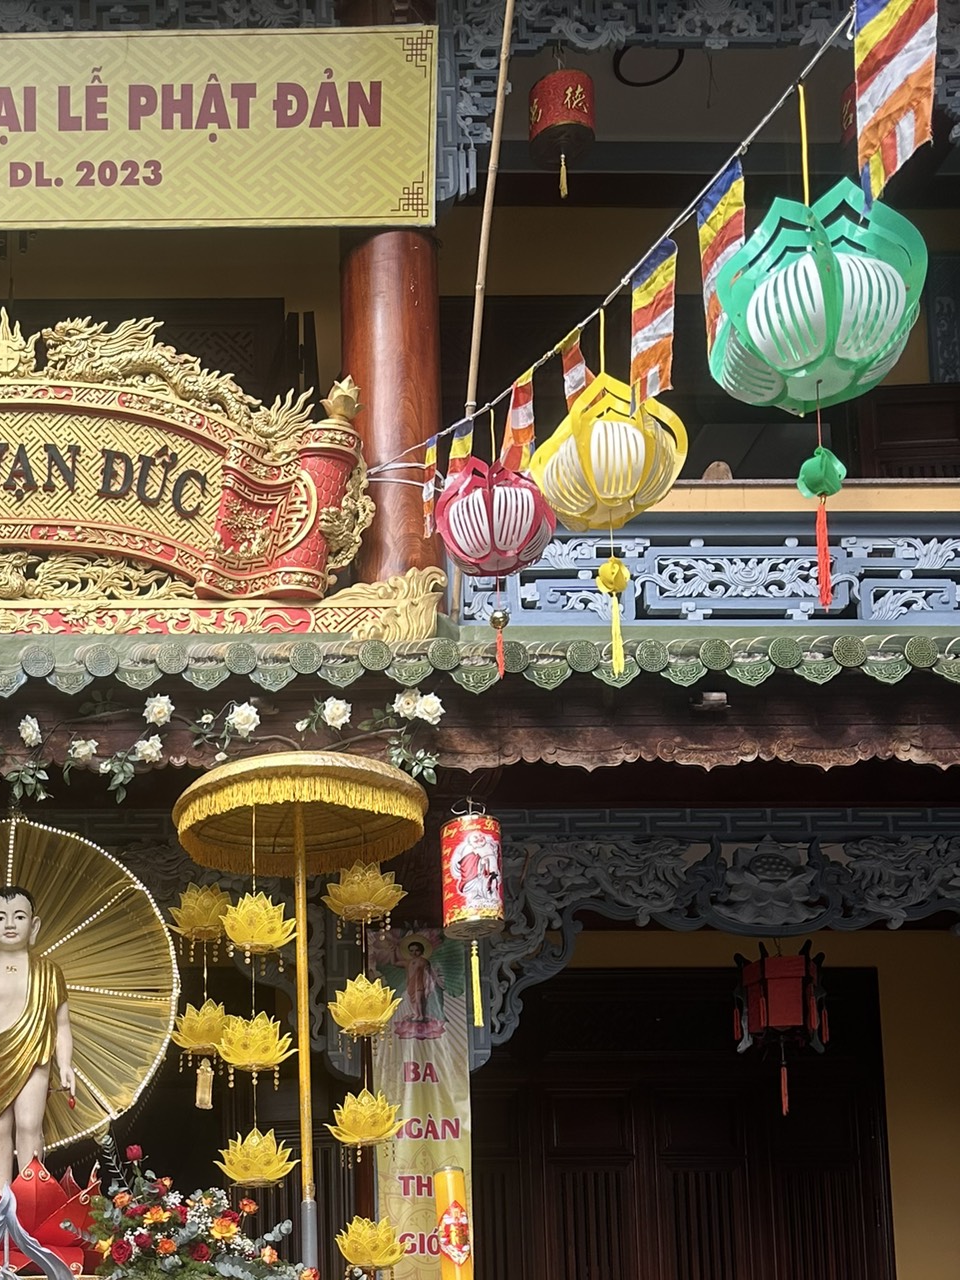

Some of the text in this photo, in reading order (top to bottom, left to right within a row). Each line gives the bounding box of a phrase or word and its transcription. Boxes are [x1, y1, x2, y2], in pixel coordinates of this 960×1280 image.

[58, 66, 109, 132] LỄ
[128, 73, 257, 143] PHẬT
[273, 67, 382, 129] ĐẢN
[9, 161, 64, 188] DL.
[75, 159, 163, 187] 2023
[97, 445, 207, 520] ĐỨC
[403, 1061, 439, 1083] BA
